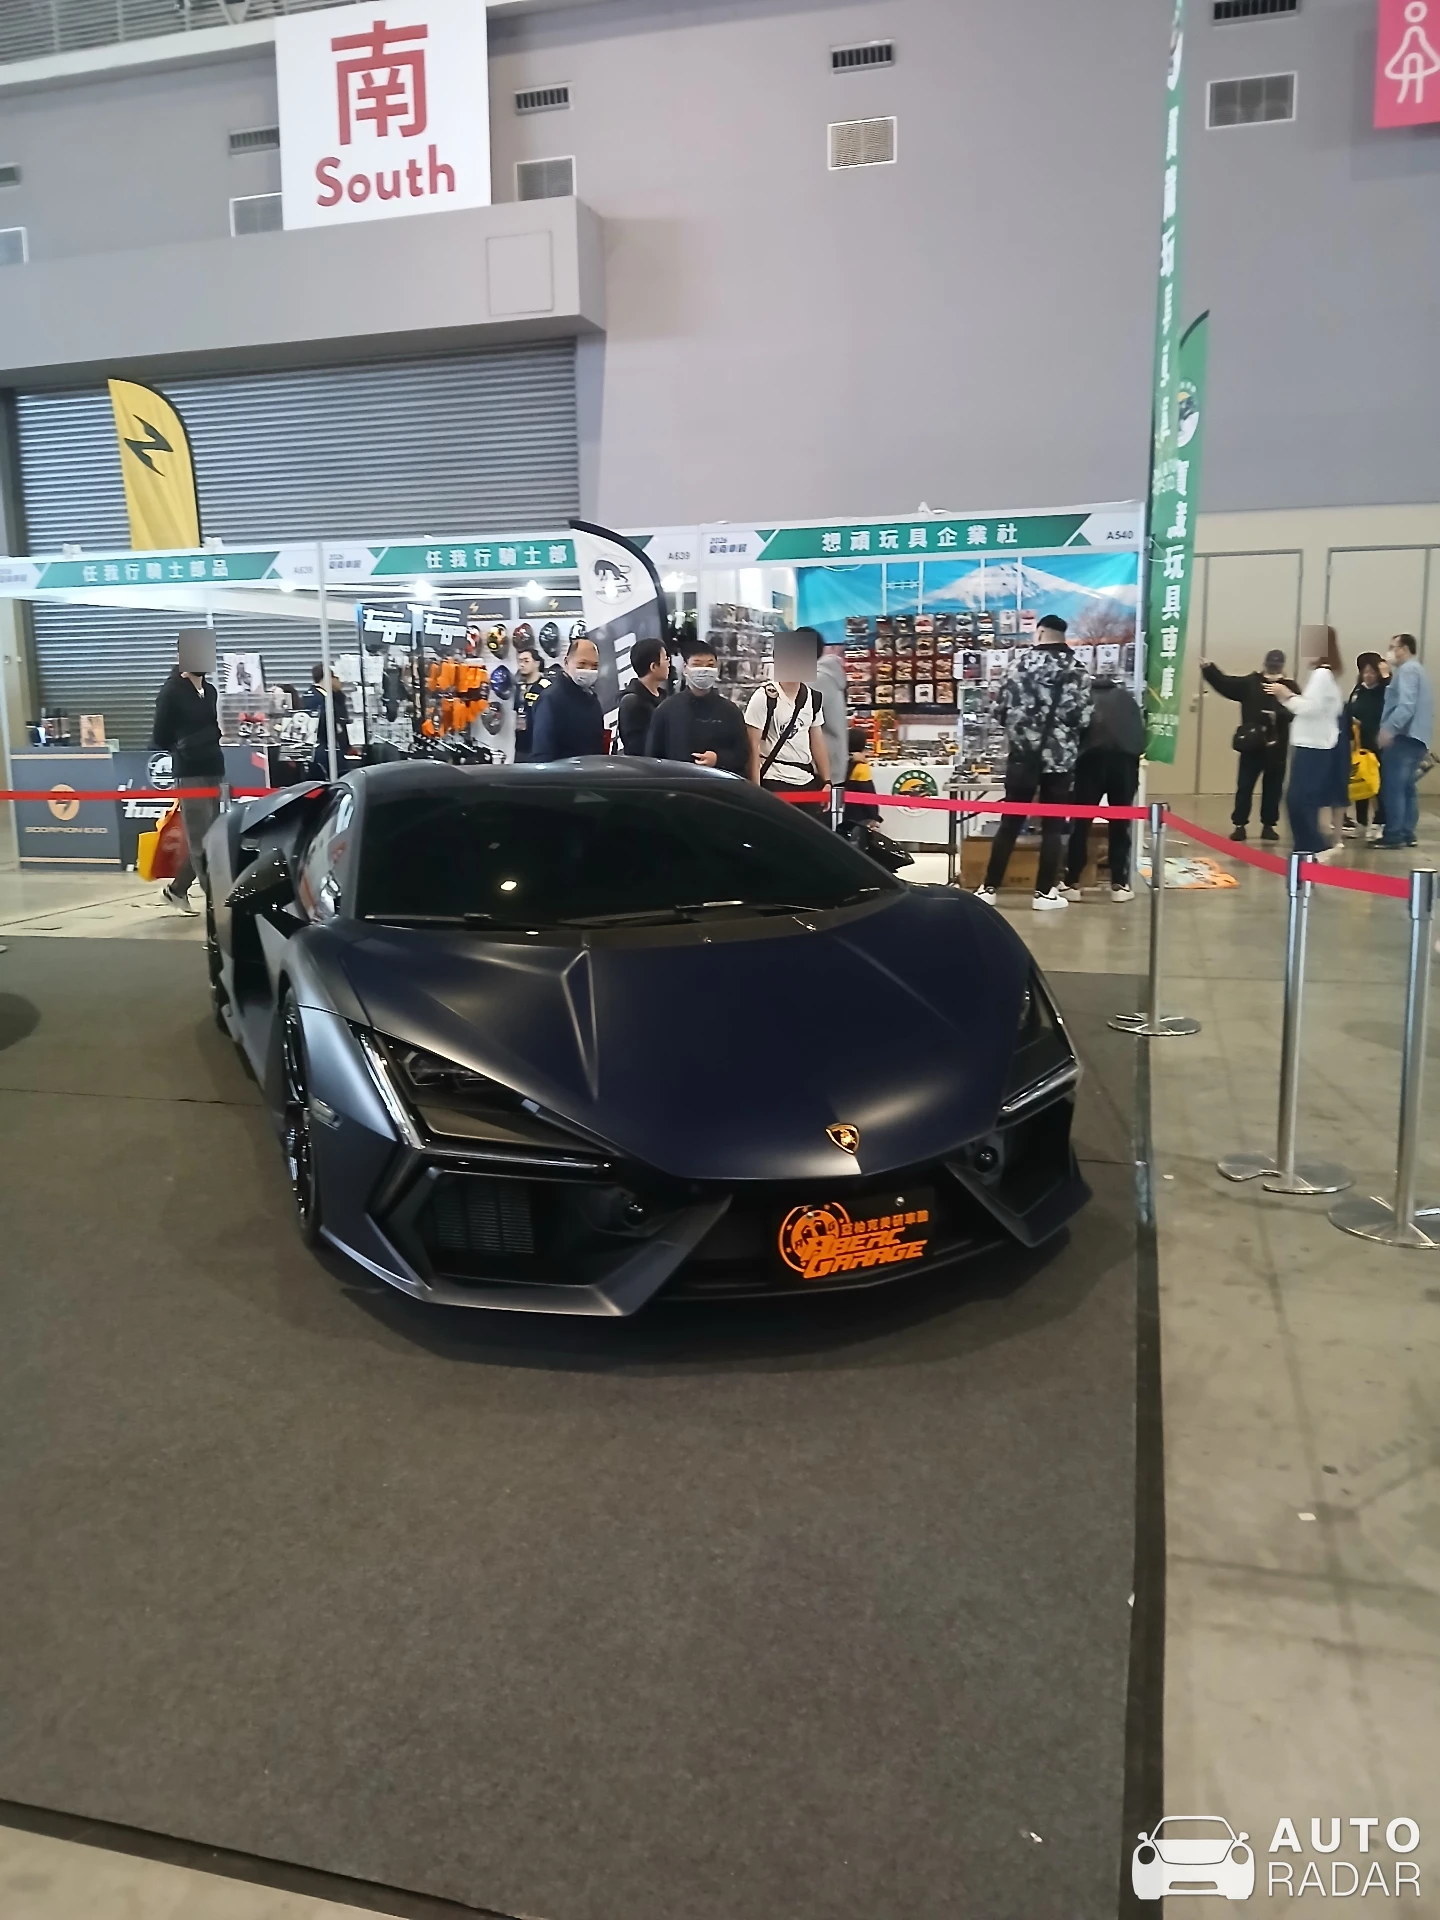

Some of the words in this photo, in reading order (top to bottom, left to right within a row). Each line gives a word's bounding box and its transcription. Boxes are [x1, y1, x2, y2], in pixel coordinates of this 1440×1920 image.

[331, 20, 428, 145] 南
[315, 144, 455, 207] South
[821, 522, 1018, 552] 想頑玩具企業社
[1105, 530, 1134, 540] A540
[82, 559, 229, 583] 任我行騎士部品
[803, 1239, 929, 1279] GARAGE
